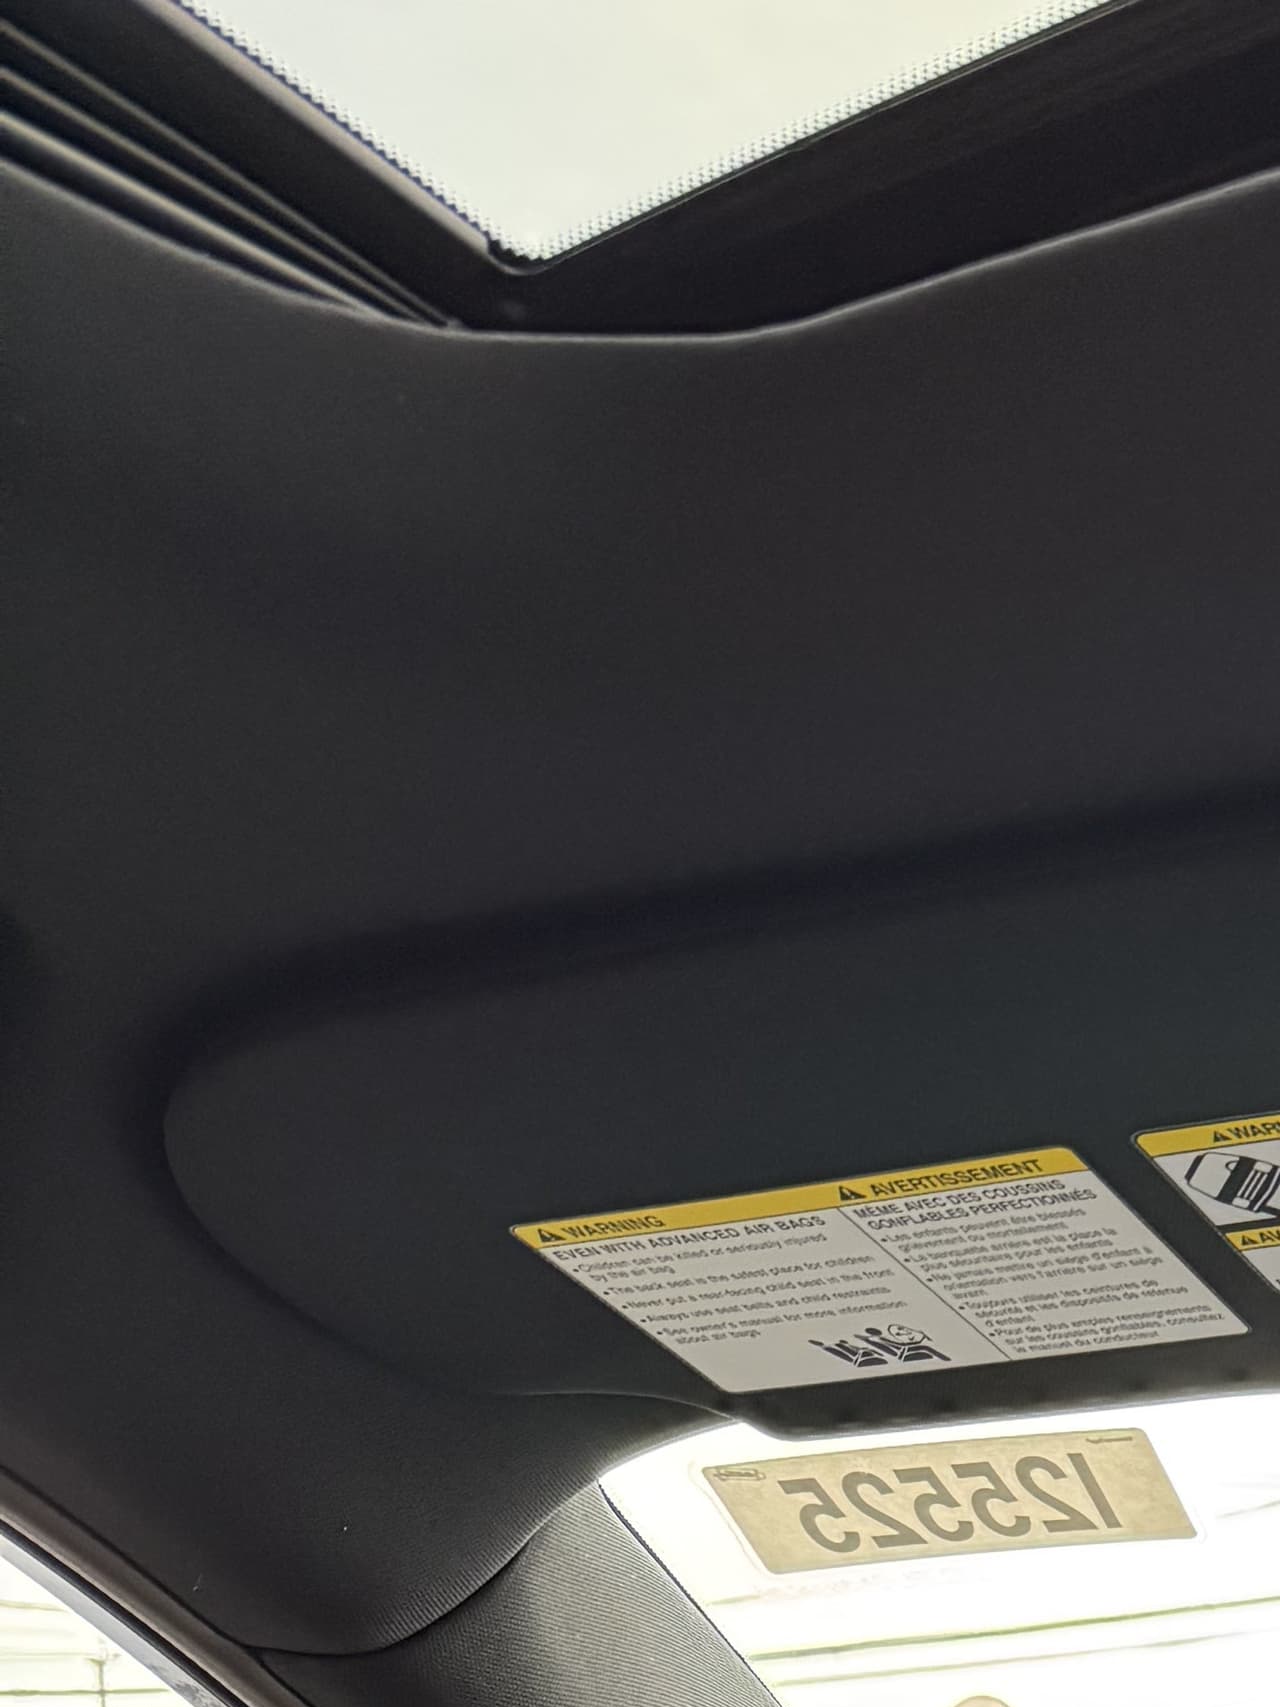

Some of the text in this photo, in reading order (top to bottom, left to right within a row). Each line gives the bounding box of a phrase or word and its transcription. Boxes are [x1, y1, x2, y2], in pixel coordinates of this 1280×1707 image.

[869, 1159, 1044, 1198] AVERTISSEMENT
[905, 1194, 947, 1212] AVEC
[950, 1189, 979, 1206] DES
[982, 1178, 1066, 1202] COUSSINS
[553, 1214, 826, 1261] EVEN WITH ADVANCED AIR BAGS
[562, 1215, 666, 1239] WARNING
